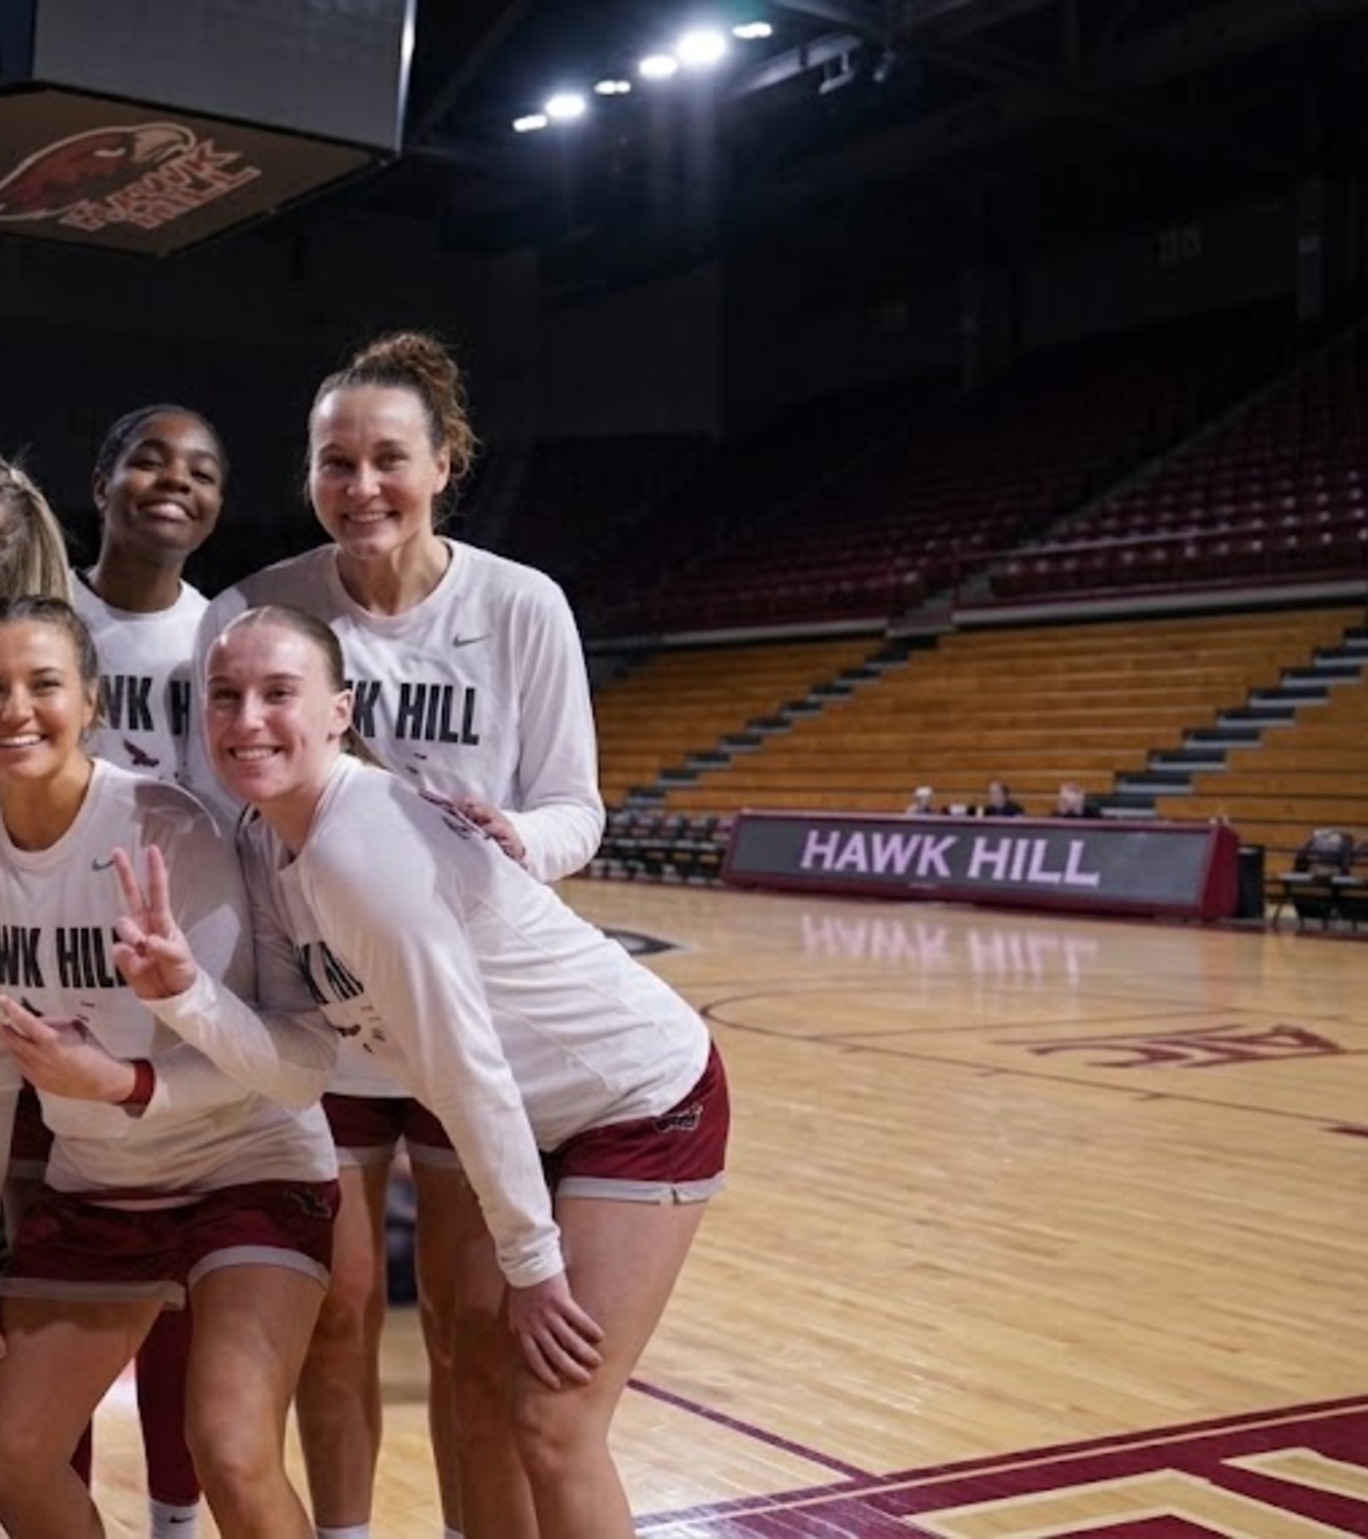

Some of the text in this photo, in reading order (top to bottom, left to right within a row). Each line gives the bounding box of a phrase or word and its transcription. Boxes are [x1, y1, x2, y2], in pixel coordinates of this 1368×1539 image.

[395, 683, 479, 745] HILL
[799, 829, 1102, 887] HAWK HILL
